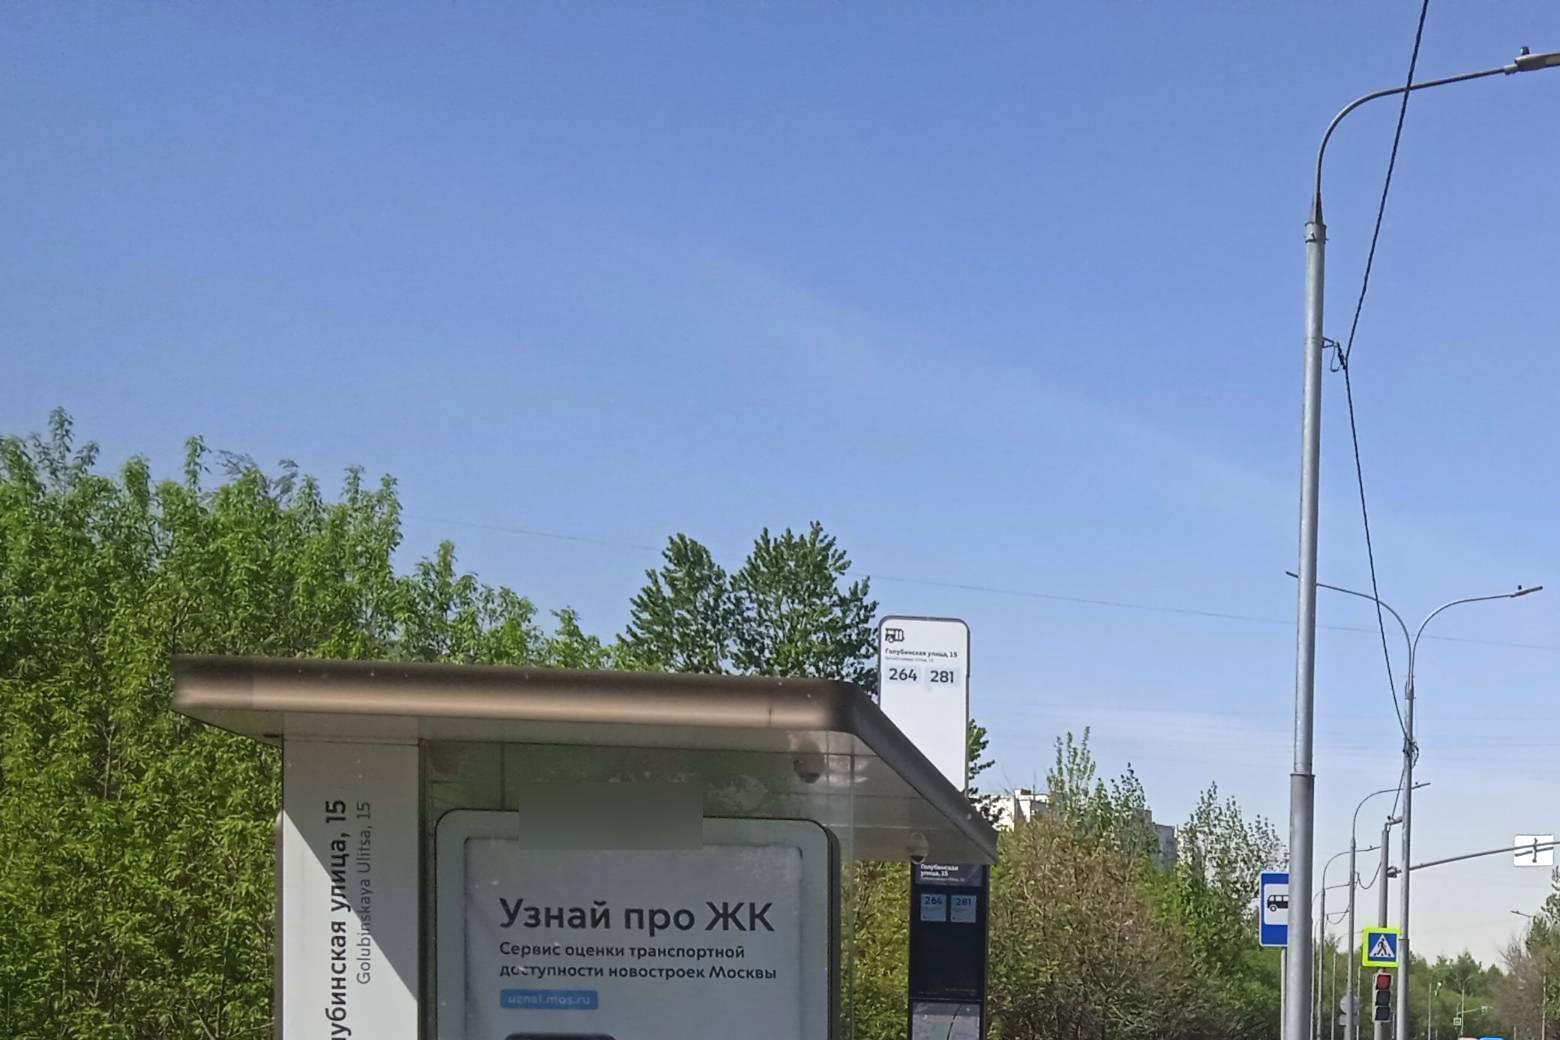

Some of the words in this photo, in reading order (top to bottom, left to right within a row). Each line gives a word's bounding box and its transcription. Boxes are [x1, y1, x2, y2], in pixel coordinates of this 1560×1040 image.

[889, 668, 917, 681] 264
[930, 670, 954, 683] 281
[326, 800, 347, 823] 15
[356, 801, 371, 820] 15
[356, 825, 374, 873] Ulitsa,
[331, 833, 351, 912] улица,
[499, 898, 611, 930] Узнай
[624, 907, 696, 937] про
[704, 901, 776, 931] ЖК
[356, 879, 374, 985] Golubinskaya
[499, 941, 561, 957] Сервис
[564, 944, 625, 959] оценки
[629, 944, 745, 960] транспортной
[499, 964, 605, 979] доступности
[608, 966, 706, 980] новостроек
[708, 965, 777, 980] Москвы
